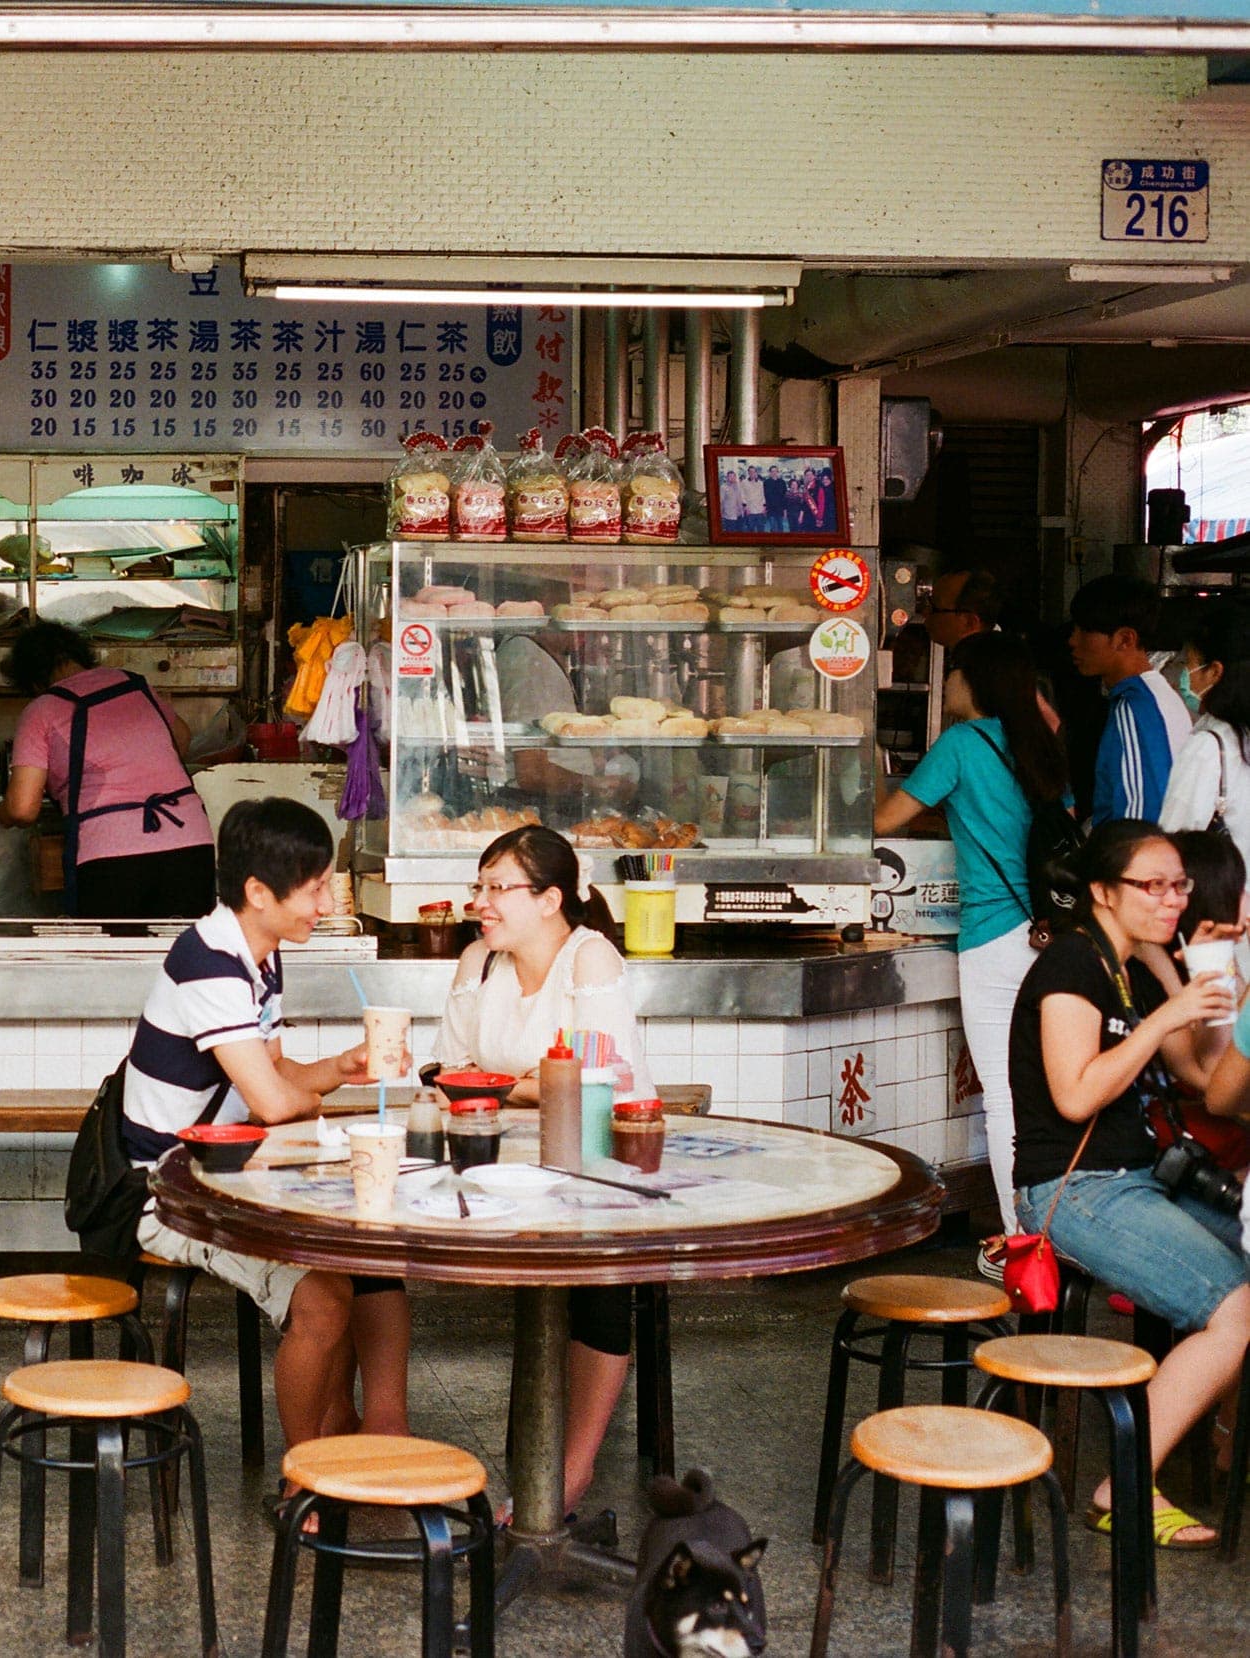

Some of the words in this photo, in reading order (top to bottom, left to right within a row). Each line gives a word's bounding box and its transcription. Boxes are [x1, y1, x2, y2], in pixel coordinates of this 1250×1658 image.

[1141, 165, 1196, 179] 成功街
[1125, 193, 1189, 238] 216
[27, 319, 58, 352] 仁
[147, 318, 178, 352] 茶
[230, 318, 261, 352] 茶
[273, 319, 304, 353] 茶
[314, 320, 345, 353] 汁
[396, 320, 426, 352] 仁
[436, 320, 467, 353] 茶
[30, 361, 57, 380] 35
[70, 361, 97, 380] 25
[110, 361, 136, 380] 25
[150, 361, 177, 380] 25
[190, 361, 217, 380] 25
[232, 362, 258, 381] 35
[275, 362, 301, 381] 25
[317, 362, 343, 381] 25
[360, 362, 386, 381] 60
[400, 362, 426, 381] 25
[438, 362, 465, 381] 25
[30, 389, 57, 408] 30
[70, 389, 97, 408] 20
[110, 389, 136, 408] 20
[150, 389, 177, 408] 20
[190, 389, 217, 408] 20
[232, 390, 258, 409] 30
[275, 390, 301, 409] 20
[317, 390, 343, 409] 20
[360, 390, 386, 409] 40
[400, 390, 426, 409] 20
[438, 390, 465, 409] 20
[30, 418, 57, 437] 20
[72, 418, 96, 437] 15
[112, 418, 136, 437] 15
[152, 418, 176, 437] 15
[193, 418, 217, 437] 15
[232, 419, 258, 438] 20
[277, 419, 300, 438] 15
[319, 419, 343, 438] 15
[361, 419, 386, 438] 30
[441, 419, 465, 438] 15
[838, 1052, 872, 1126] 茶
